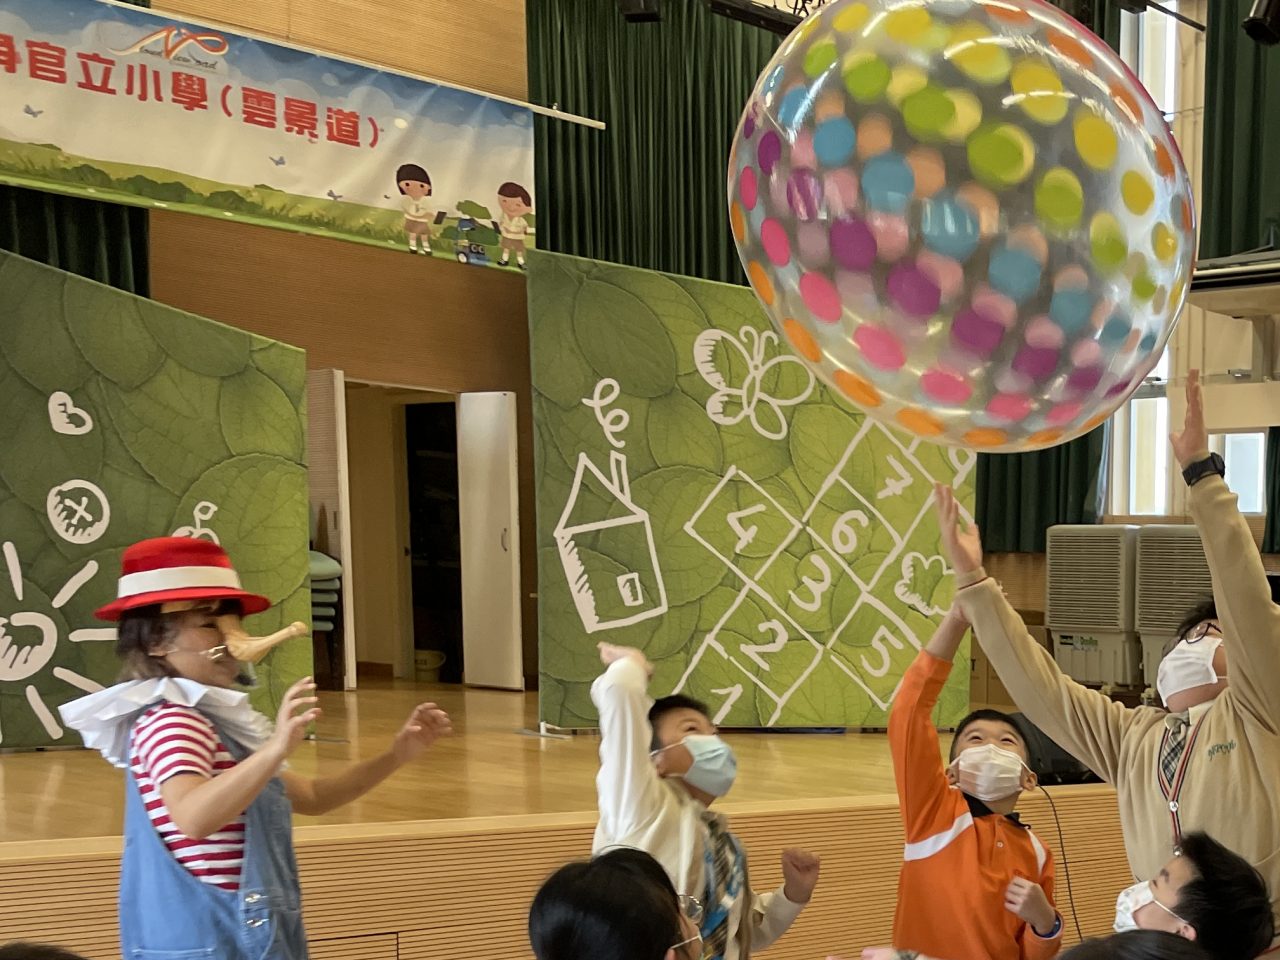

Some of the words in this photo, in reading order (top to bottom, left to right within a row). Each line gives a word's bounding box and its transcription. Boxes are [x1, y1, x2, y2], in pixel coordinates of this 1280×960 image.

[726, 503, 767, 553] 4
[831, 509, 870, 554] 6
[788, 554, 831, 613] 3
[739, 618, 789, 672] 2
[860, 624, 904, 678] 5
[710, 682, 743, 725] 1
